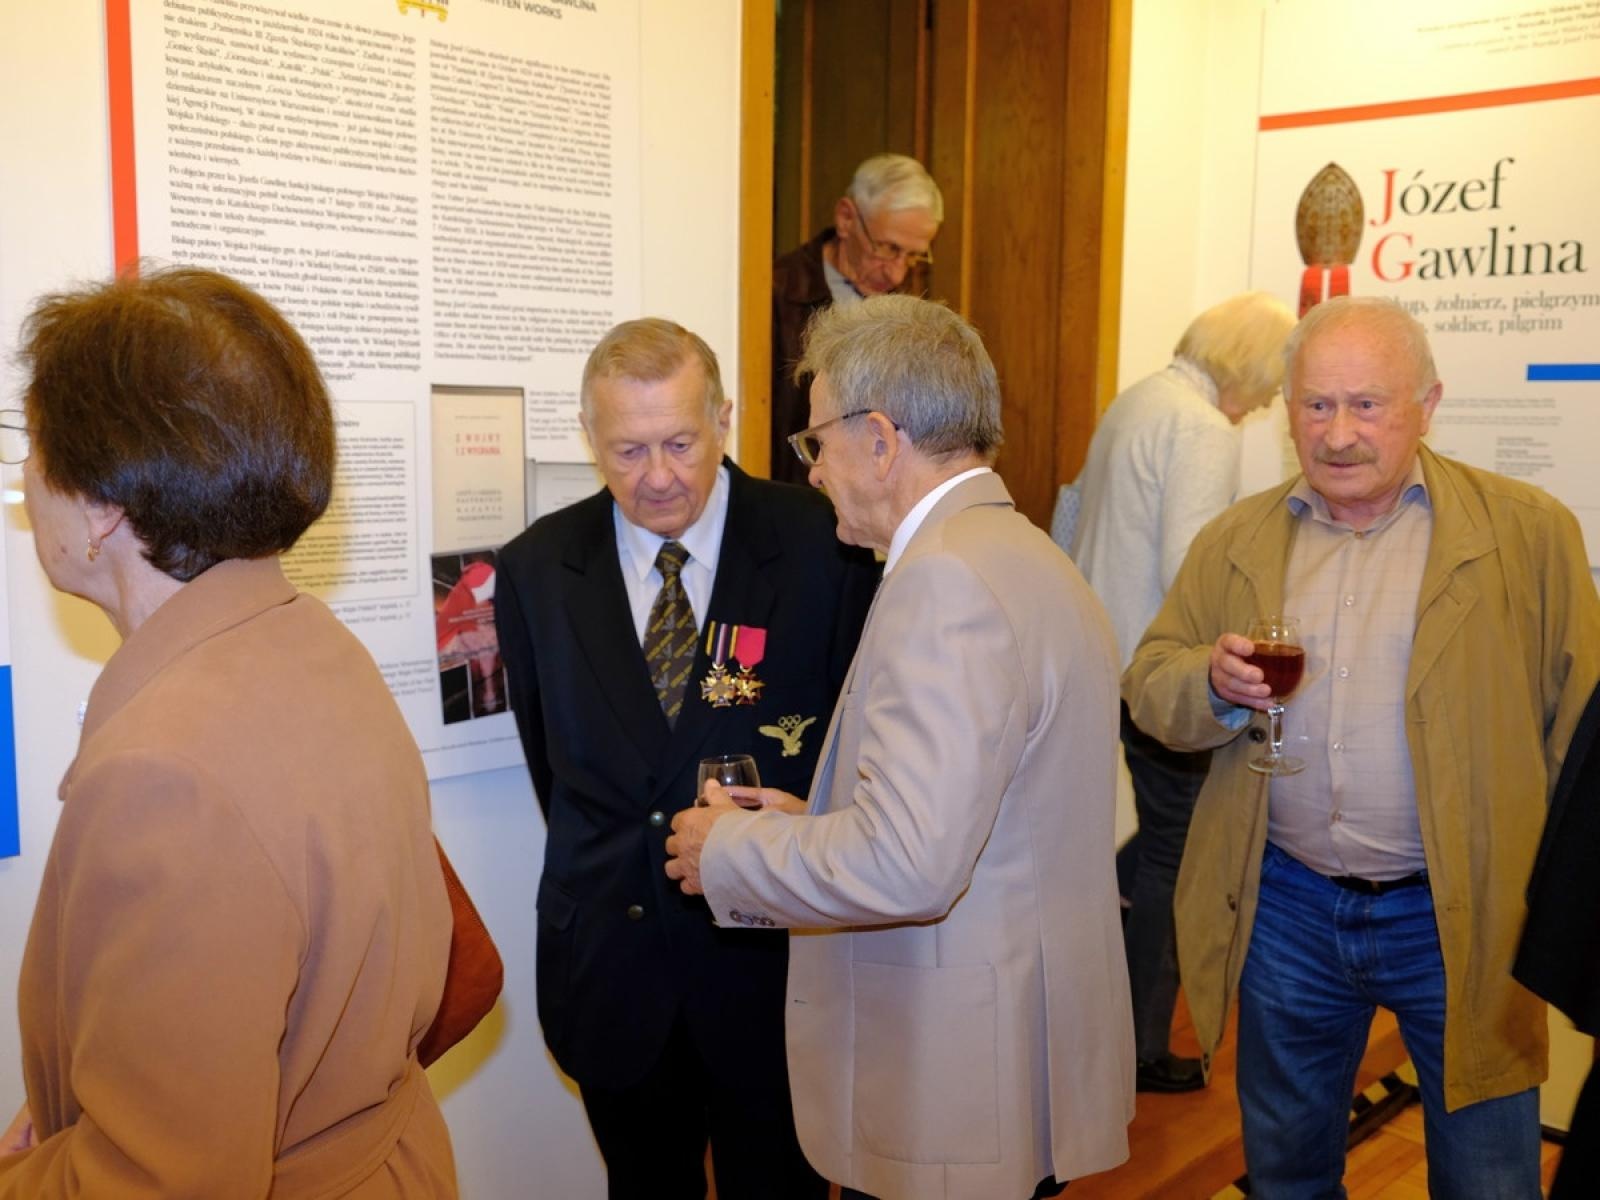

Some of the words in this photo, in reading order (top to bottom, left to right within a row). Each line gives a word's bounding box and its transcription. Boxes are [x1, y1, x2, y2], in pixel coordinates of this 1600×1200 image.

[523, 3, 563, 20] WORKS
[1369, 157, 1515, 227] Józef
[1371, 225, 1588, 283] Gawlina
[1434, 315, 1493, 333] soldier,
[1500, 313, 1563, 335] pilgrim
